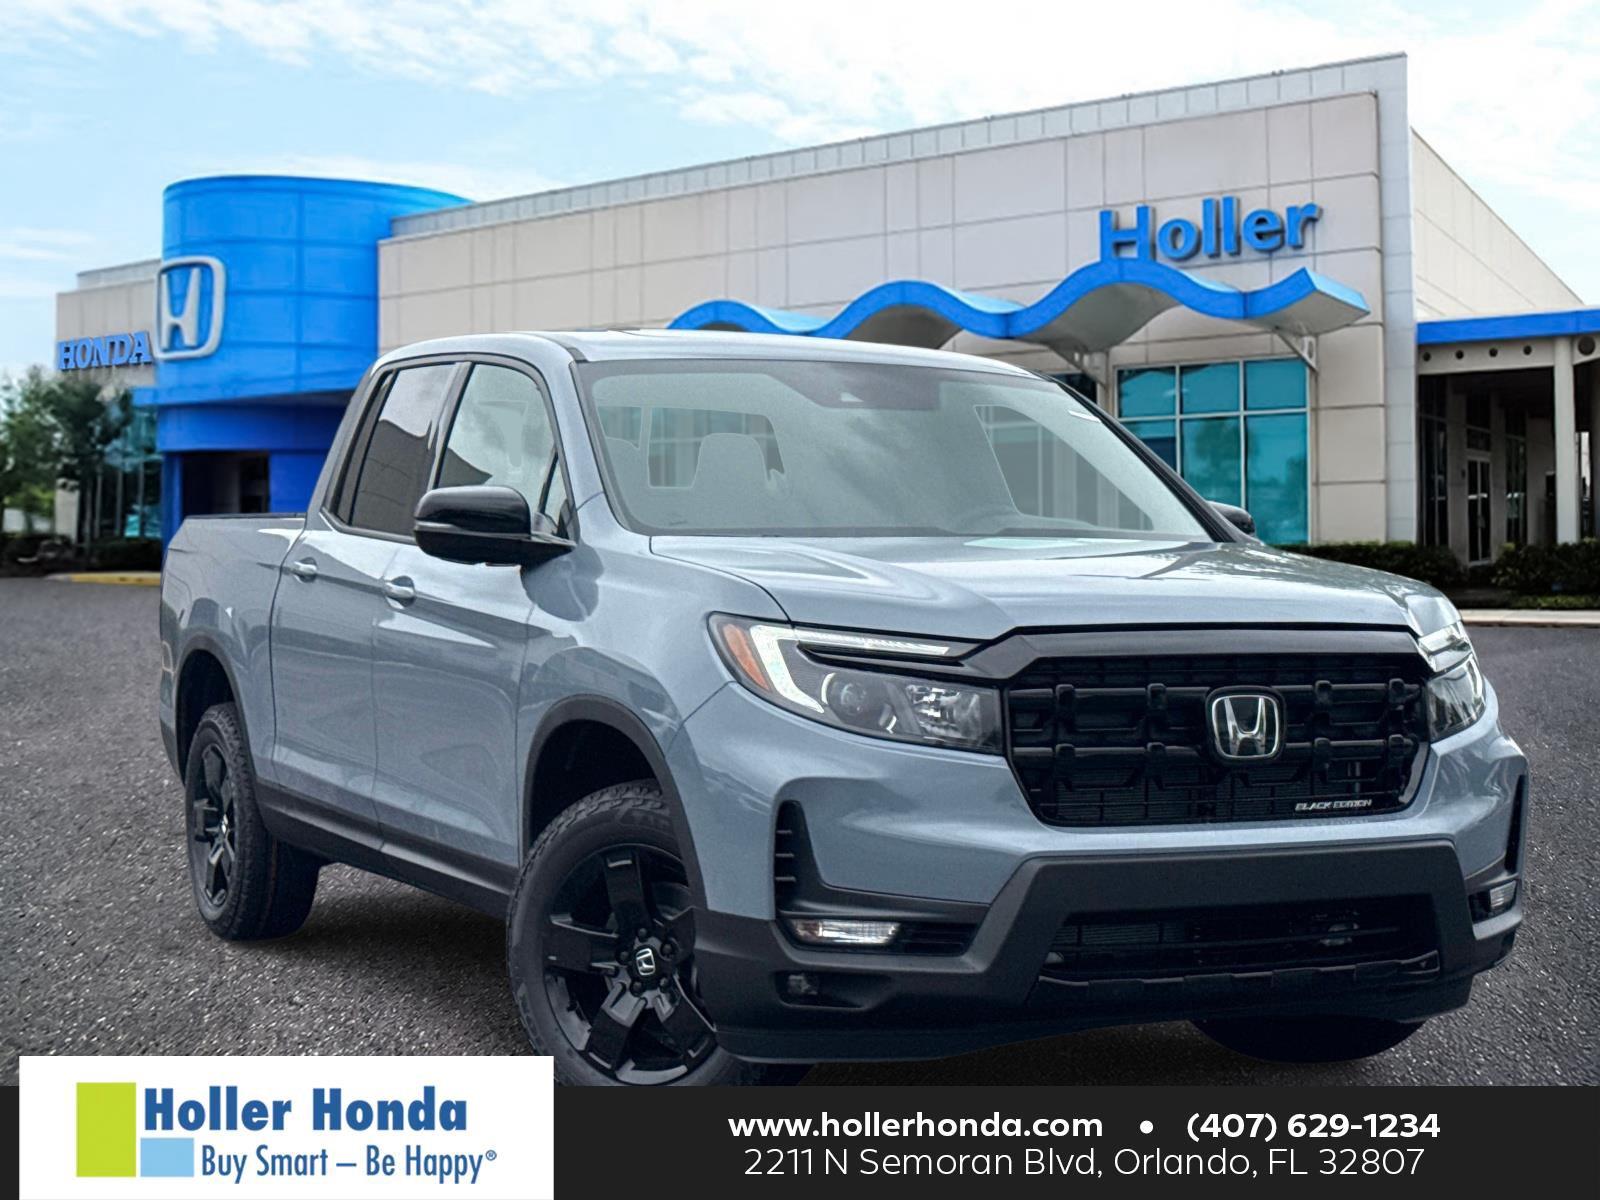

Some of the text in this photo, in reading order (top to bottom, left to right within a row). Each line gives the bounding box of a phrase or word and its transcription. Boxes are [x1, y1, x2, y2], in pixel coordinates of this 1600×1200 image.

[1099, 196, 1323, 260] Holler
[57, 331, 152, 371] HONDA
[1295, 802, 1332, 811] BLACK
